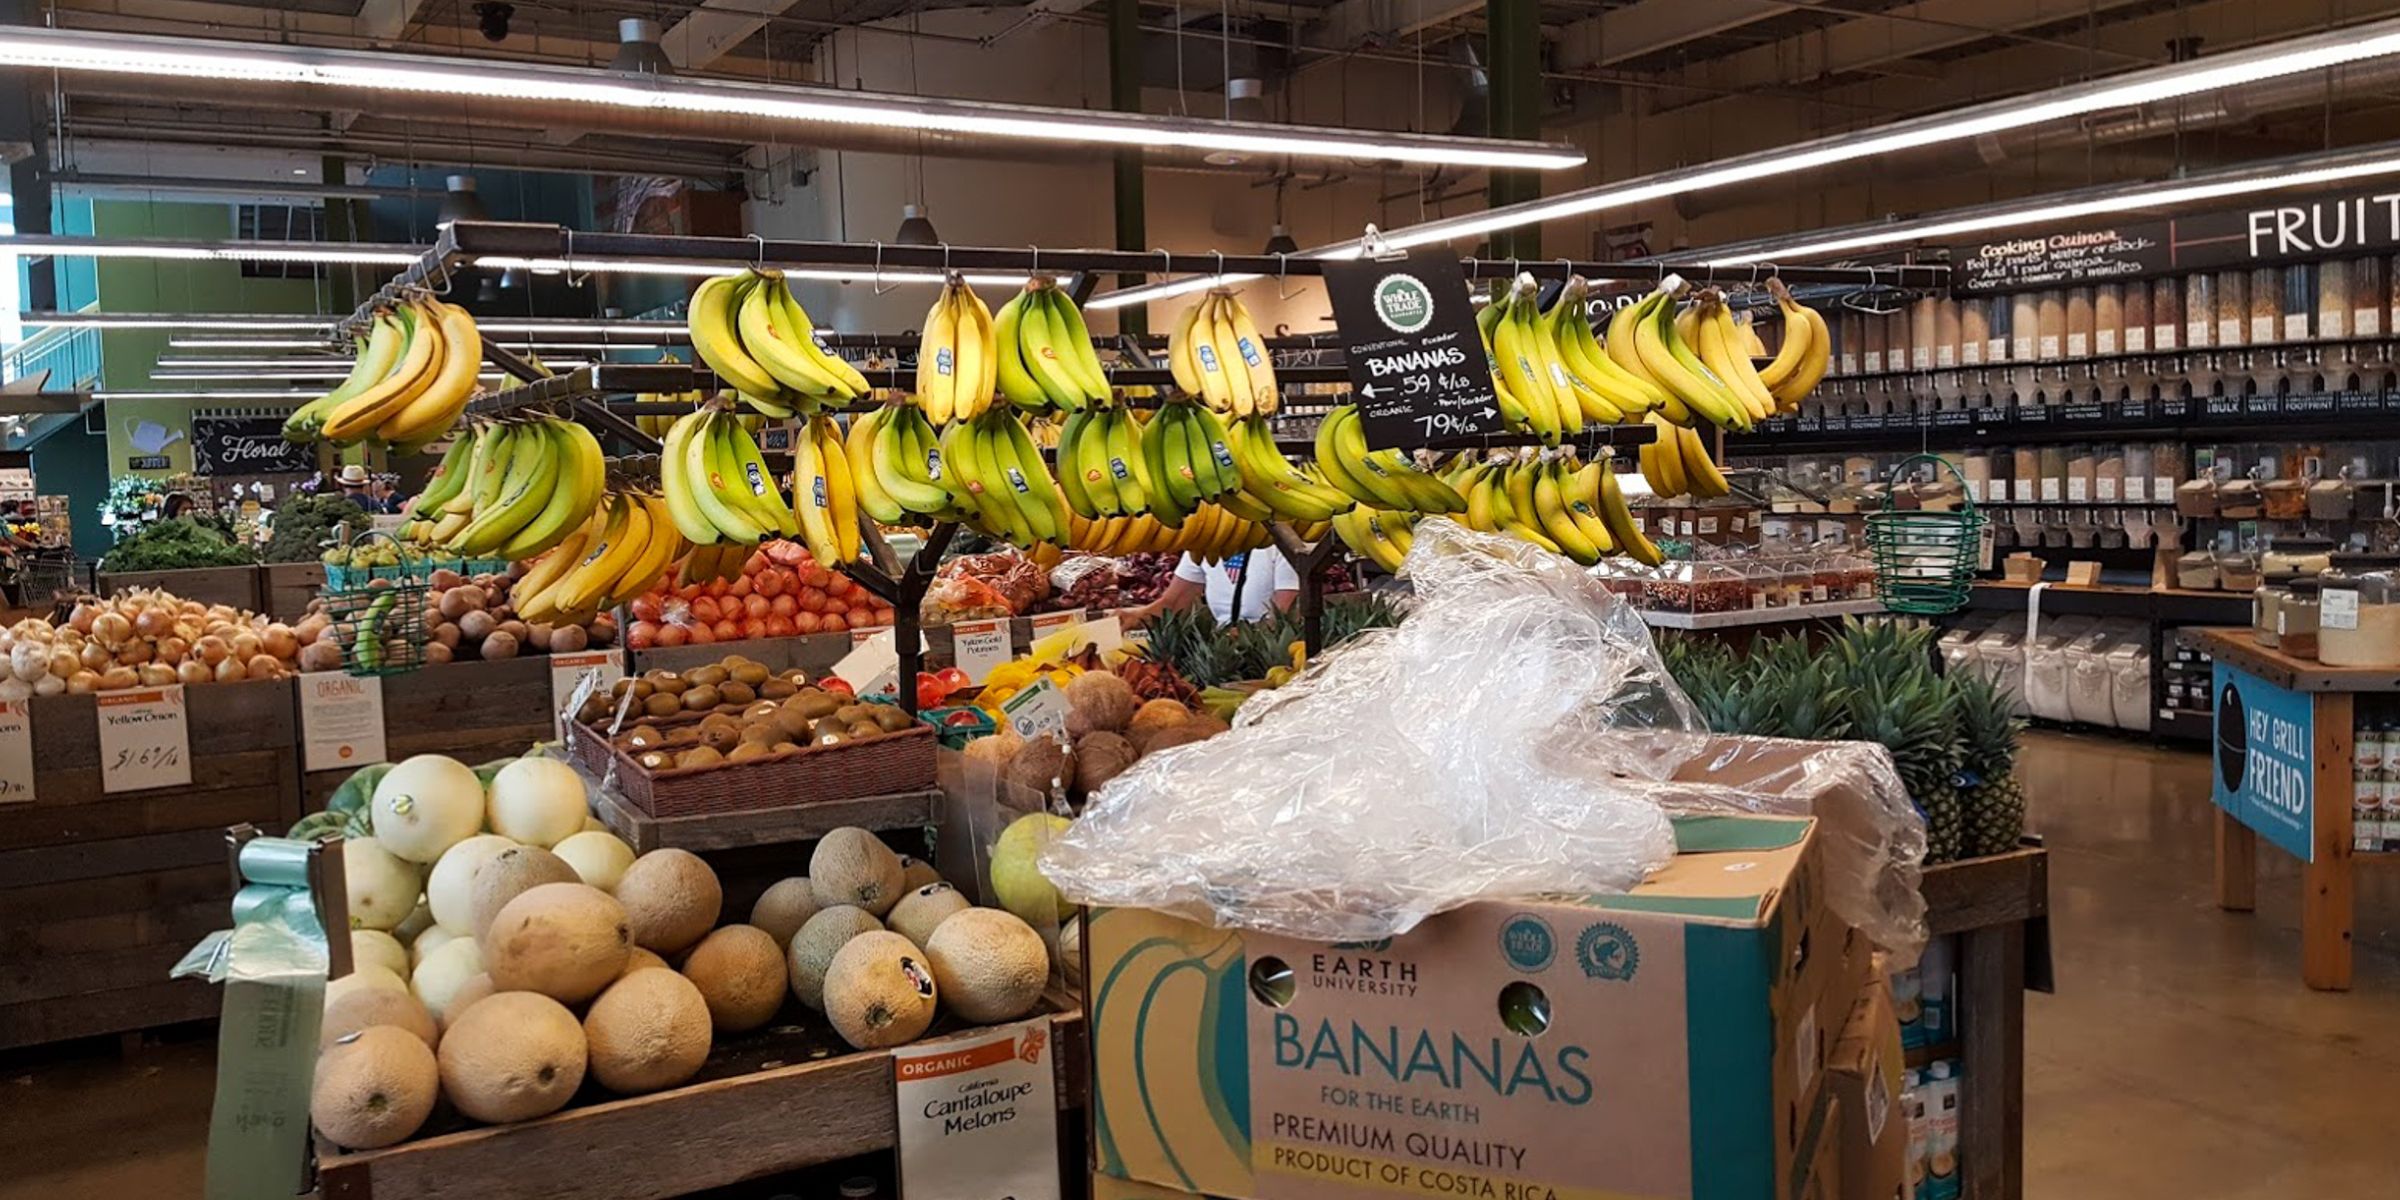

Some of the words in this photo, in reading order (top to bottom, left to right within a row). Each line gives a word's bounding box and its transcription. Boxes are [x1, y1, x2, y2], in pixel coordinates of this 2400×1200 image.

[2249, 193, 2400, 257] FRUIT
[1967, 257, 1989, 270] Boil
[1994, 257, 2003, 268] 2
[2007, 252, 2041, 267] parts
[2092, 245, 2107, 254] or
[1980, 238, 2045, 258] Cooking
[2049, 230, 2121, 248] Quinoa
[1968, 278, 1996, 290] Cover
[2088, 260, 2142, 277] minutes
[1981, 268, 2006, 279] Add
[2022, 262, 2048, 276] part
[1382, 289, 1421, 303] WHOLE
[1387, 299, 1422, 312] TRADE
[1351, 339, 1409, 354] CONVENTIONAL
[1364, 347, 1466, 377] BANANAS
[1369, 405, 1414, 418] ORGANIC
[2249, 402, 2279, 412] WASTE
[2285, 401, 2333, 411] FOOTPRINT
[221, 434, 291, 463] Floral
[107, 714, 142, 726] Yellow
[144, 712, 178, 722] Onion
[2249, 707, 2269, 744] HEY
[2273, 717, 2305, 760] GRILL
[2249, 747, 2305, 815] FRIEND
[1312, 952, 1417, 983] EARTH
[1312, 975, 1417, 998] UNIVERSITY
[903, 1055, 972, 1075] ORGANIC
[1274, 1012, 1593, 1106] BANANAS
[924, 1080, 1033, 1119] Cantaloupe
[958, 1078, 999, 1093] California
[1321, 1086, 1359, 1107] FOR
[1367, 1094, 1404, 1114] THE
[1411, 1100, 1481, 1124] EARTH
[944, 1106, 1016, 1136] Melons
[1273, 1112, 1395, 1152] PREMIUM
[1405, 1132, 1527, 1171] QUALITY
[1274, 1147, 1373, 1181] PRODUCT
[1380, 1163, 1411, 1186] OF
[1418, 1170, 1496, 1199] COSTA
